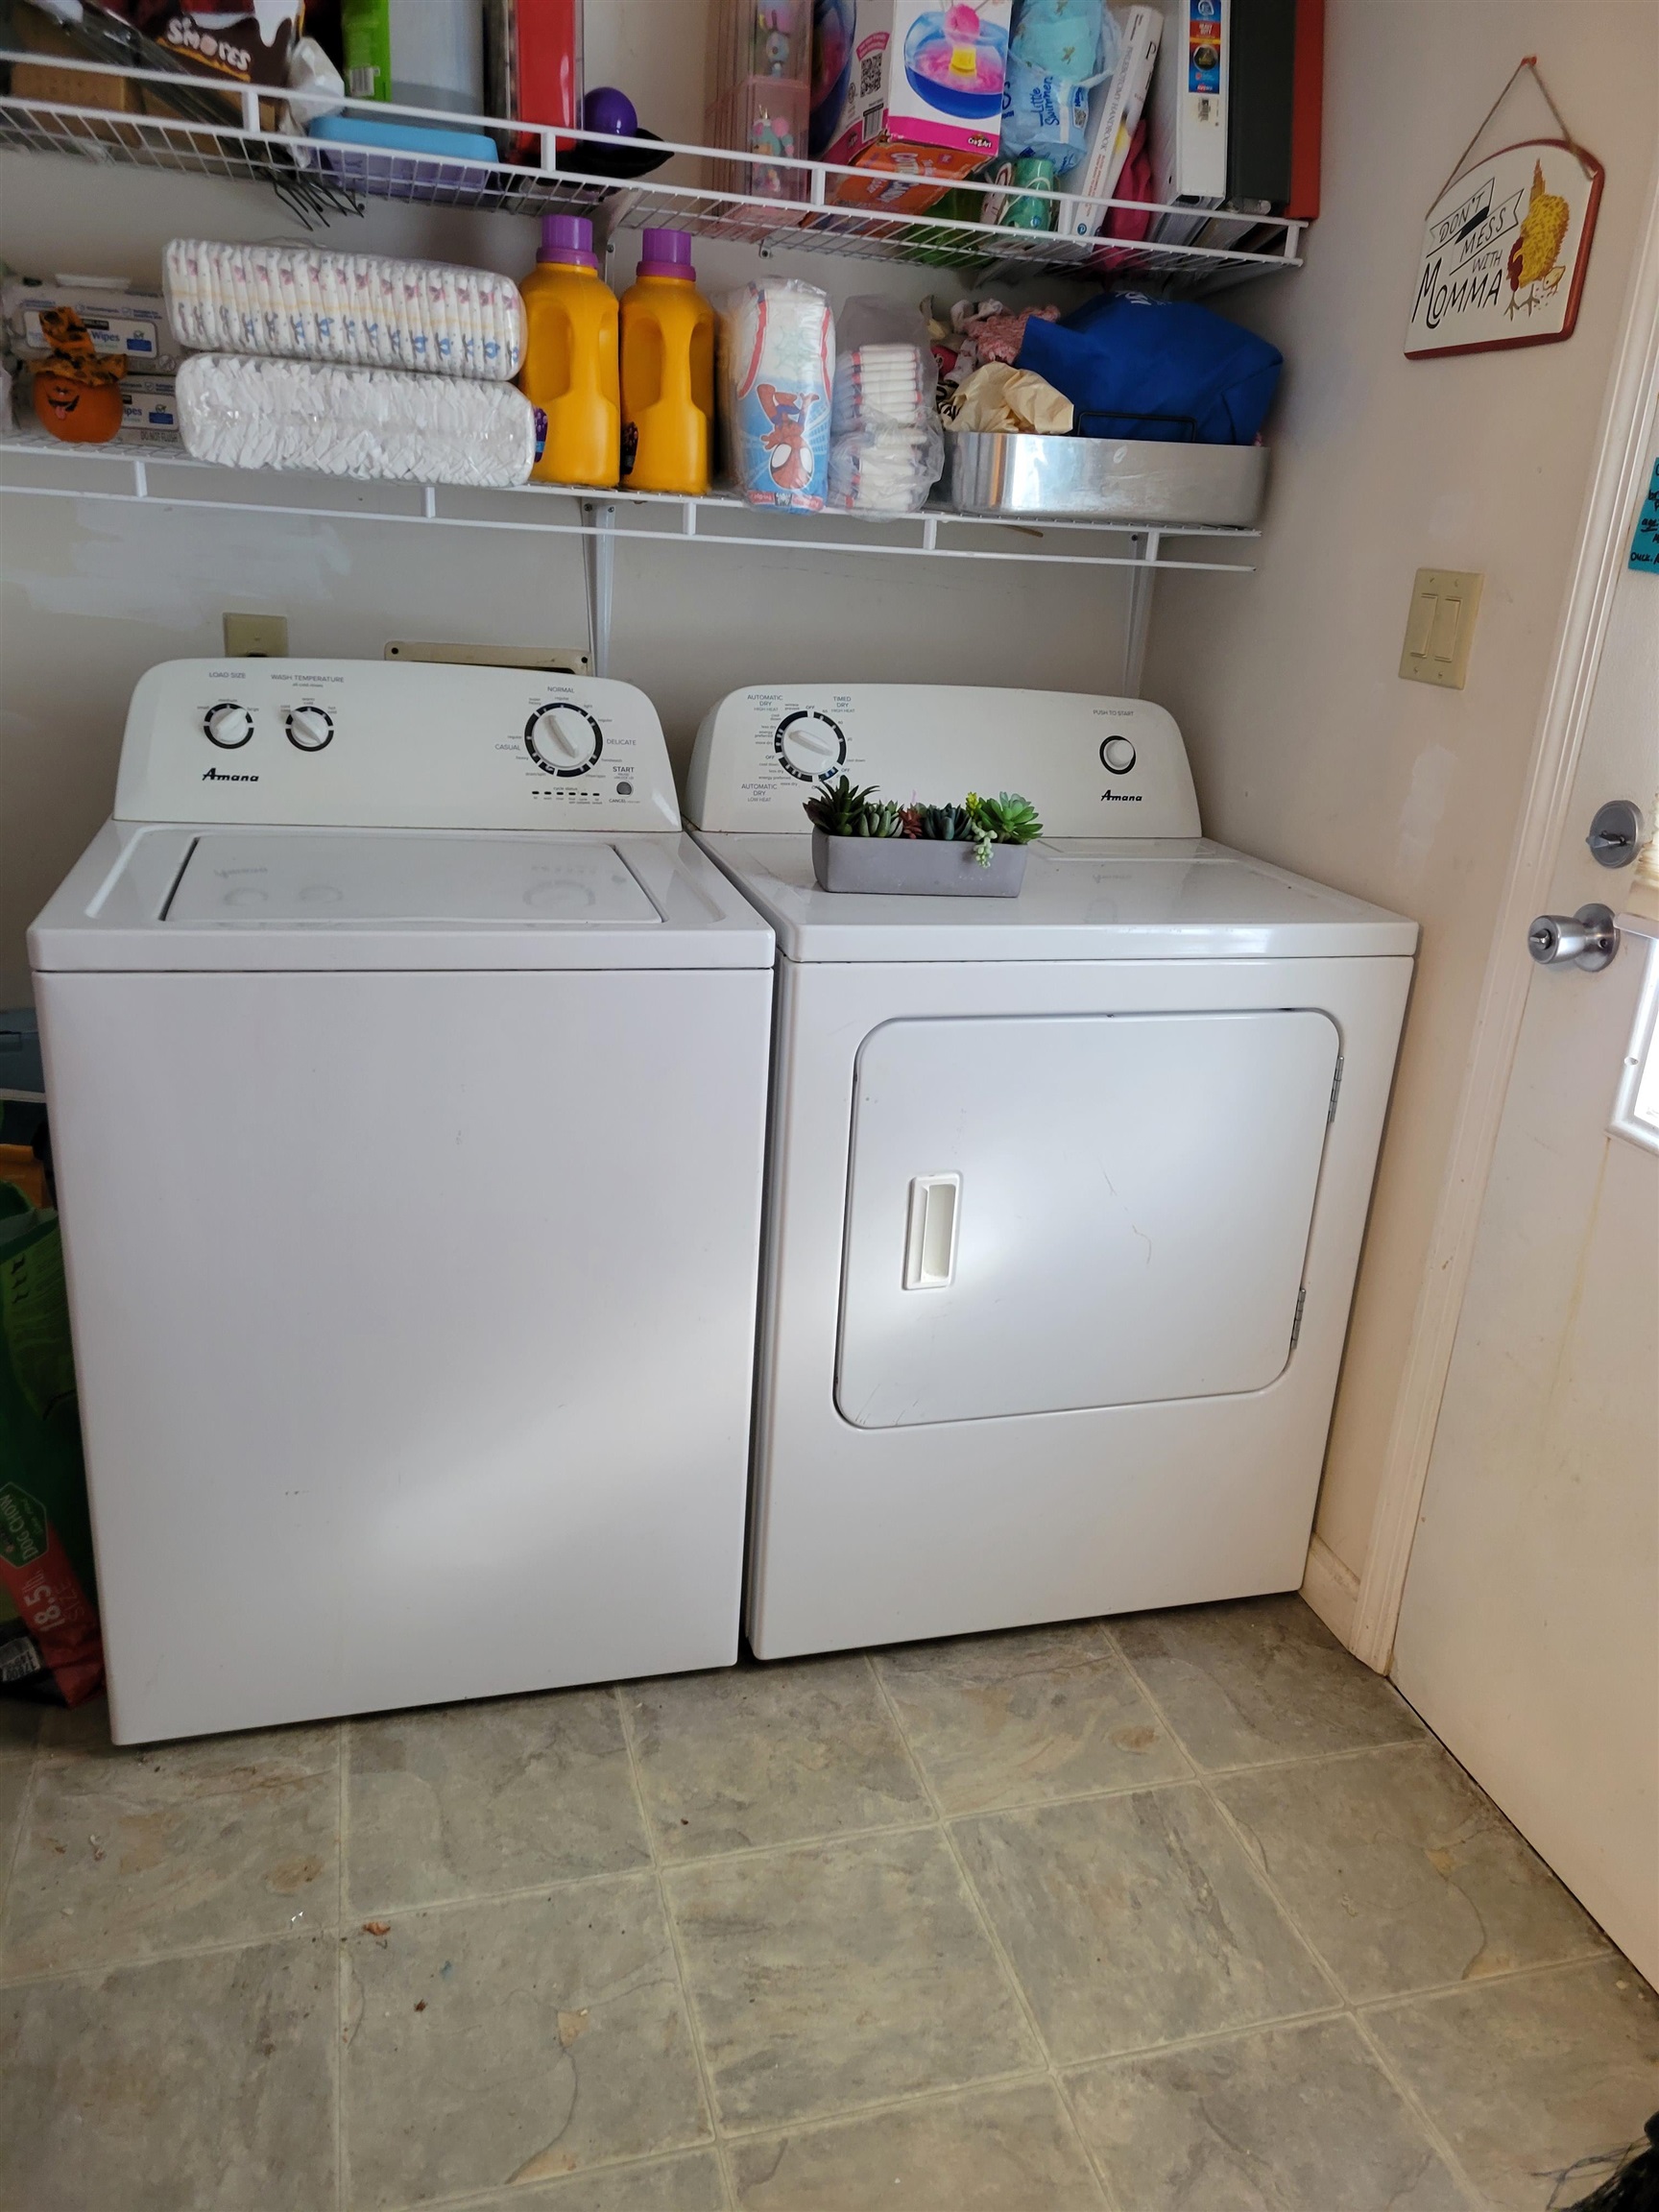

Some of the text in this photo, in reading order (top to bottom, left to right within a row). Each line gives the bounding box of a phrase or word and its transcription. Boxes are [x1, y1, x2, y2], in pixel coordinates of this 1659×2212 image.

[1029, 86, 1045, 127] Little
[1100, 102, 1118, 151] HANDBOOK
[1439, 191, 1485, 244] DON'T
[1459, 206, 1506, 263] MESS
[1472, 250, 1503, 274] WITH
[1411, 256, 1503, 329] MOMMA
[92, 330, 120, 343] Wipes
[294, 675, 345, 684] TEMPERATURE
[202, 768, 259, 781] Amana
[1100, 789, 1142, 801] Amana
[0, 1493, 25, 1534] CHOW
[16, 1533, 39, 1561] DOG
[23, 1583, 66, 1632] 18.5
[56, 1576, 84, 1621] SIZE
